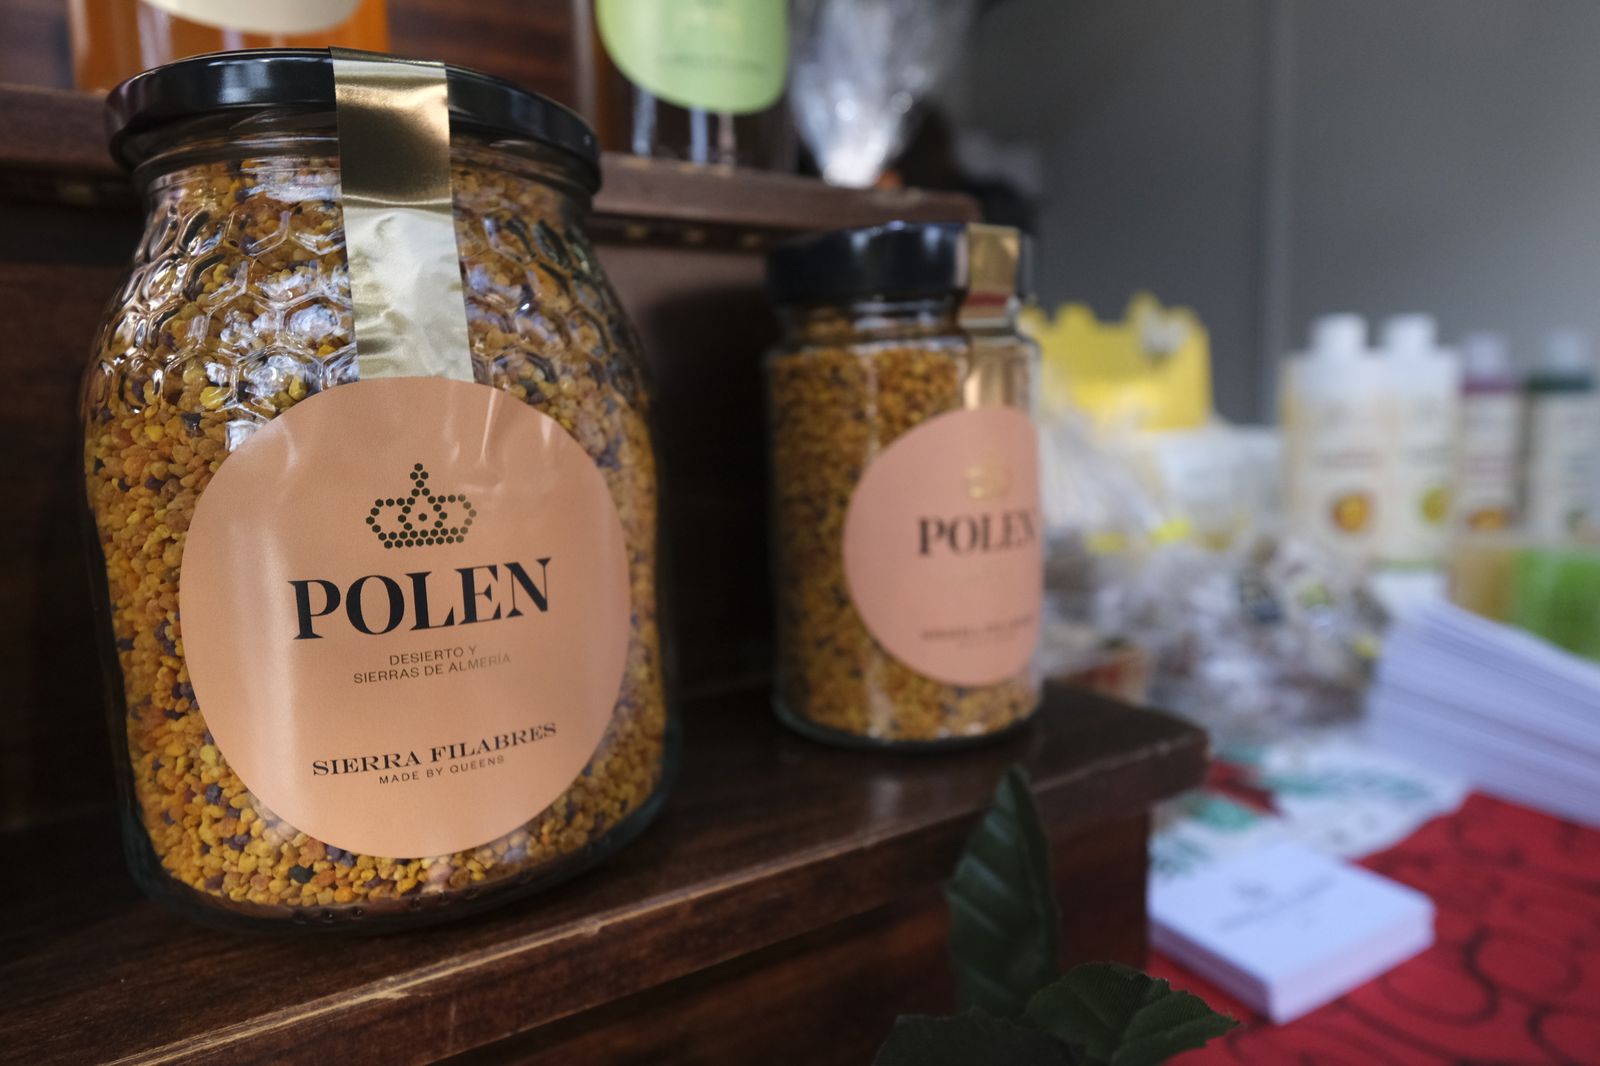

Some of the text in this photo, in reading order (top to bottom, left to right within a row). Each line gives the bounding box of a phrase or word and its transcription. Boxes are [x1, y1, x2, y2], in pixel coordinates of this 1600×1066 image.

[288, 557, 552, 640] POLEN
[389, 645, 477, 666] DESIERTO Y
[353, 667, 420, 684] SIERRAS
[424, 664, 444, 677] DE
[312, 722, 557, 777] SIERRA FILABRES
[379, 754, 505, 785] MADE BY QUEENS
